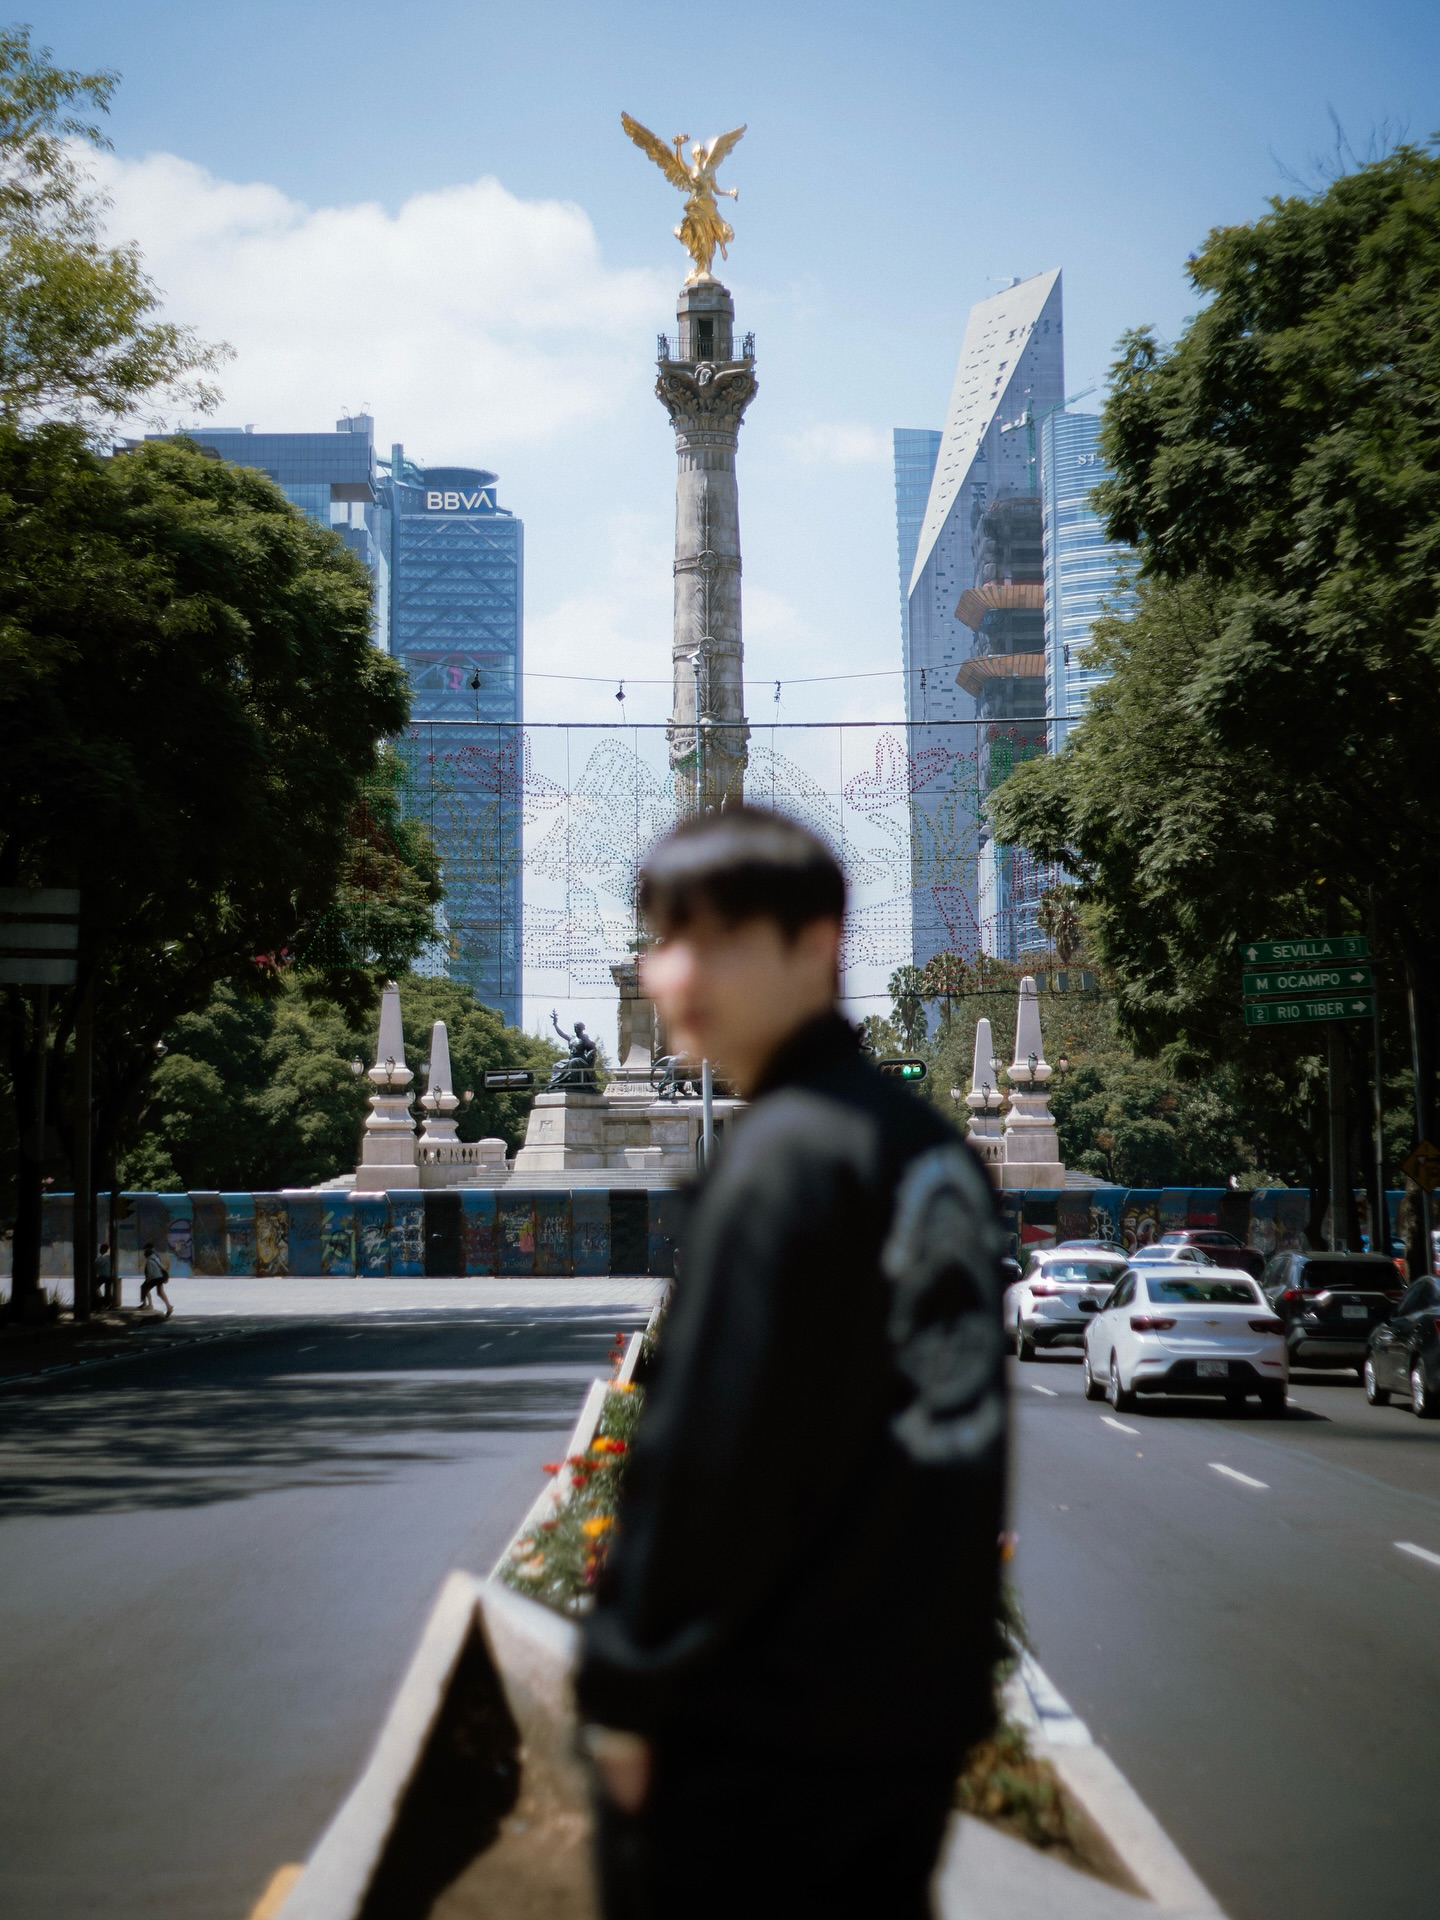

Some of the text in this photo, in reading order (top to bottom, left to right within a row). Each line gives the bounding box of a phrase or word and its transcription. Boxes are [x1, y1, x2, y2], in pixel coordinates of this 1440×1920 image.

[427, 490, 493, 510] BBVA
[1272, 943, 1333, 958] SEVILLA
[1256, 973, 1340, 990] M OCAMPO
[1256, 1002, 1345, 1019] 2 RIO TIBER
